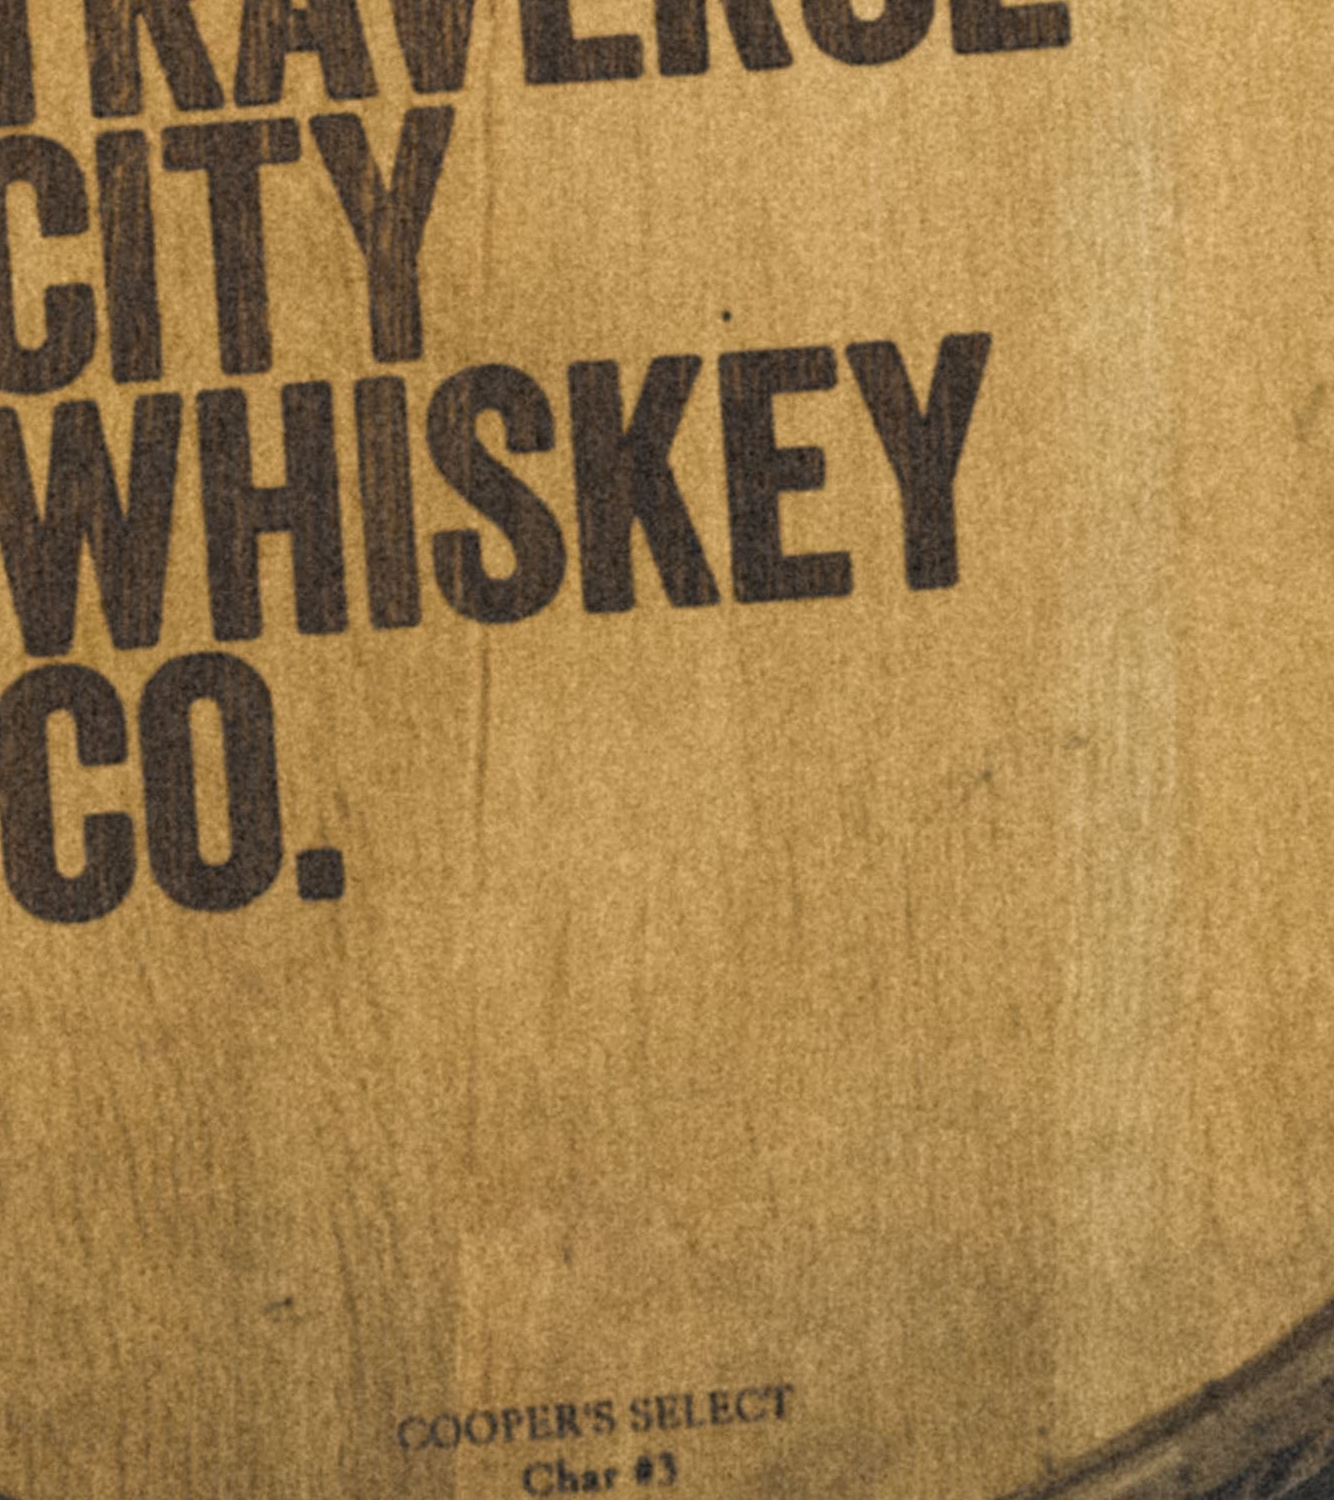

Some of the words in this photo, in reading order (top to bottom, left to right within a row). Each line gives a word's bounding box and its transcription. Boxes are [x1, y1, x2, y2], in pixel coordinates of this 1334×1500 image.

[396, 1399, 617, 1452] COOPER'S
[629, 1384, 794, 1434] SELECT
[522, 1456, 618, 1498] Char
[634, 1451, 678, 1487] #3
